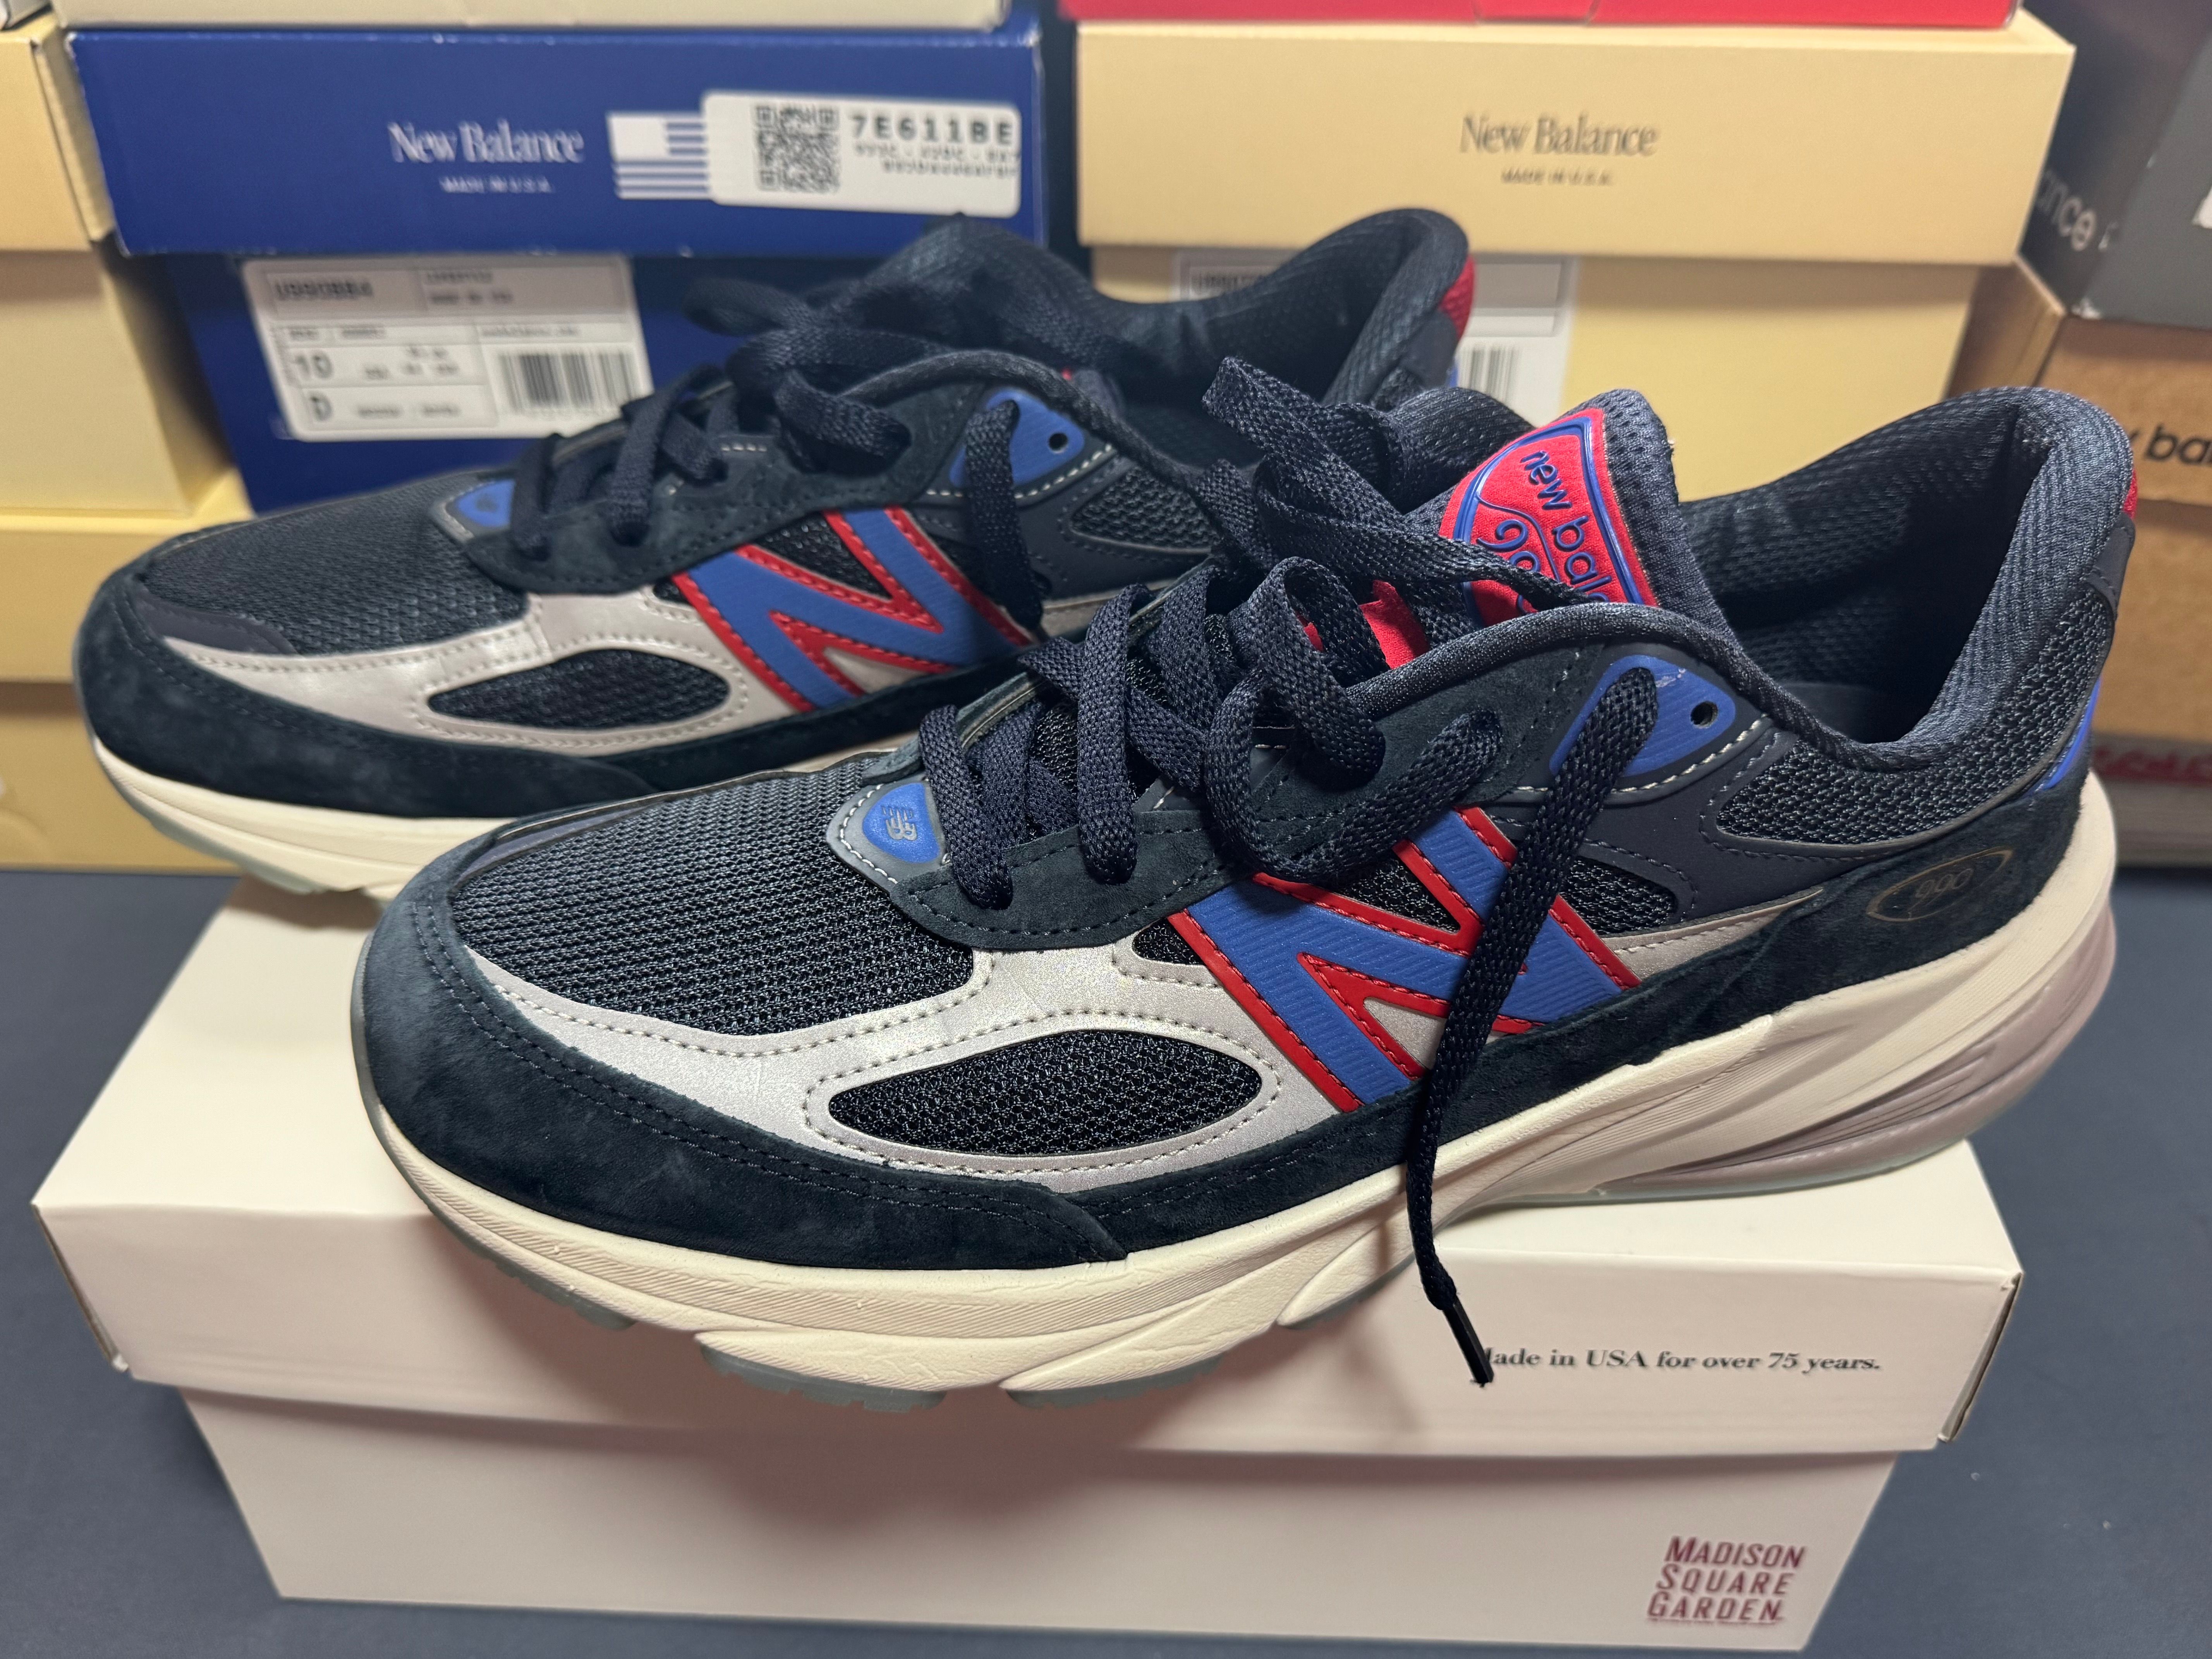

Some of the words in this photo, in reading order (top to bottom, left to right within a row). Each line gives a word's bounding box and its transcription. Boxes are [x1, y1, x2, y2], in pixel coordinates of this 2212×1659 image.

[387, 119, 457, 163] New
[459, 117, 584, 163] Balance
[852, 112, 1015, 145] 7E611BE
[1460, 112, 1530, 153] New
[1534, 112, 1659, 156] Balance
[2145, 423, 2212, 465] ba
[1520, 450, 1573, 510] new
[1484, 1347, 1540, 1365] ade
[1549, 1349, 1575, 1365] in
[1586, 1349, 1647, 1368] USA
[1656, 1351, 1695, 1368] for
[1702, 1356, 1760, 1369] over
[1767, 1352, 1800, 1369] 75
[1802, 1357, 1881, 1374] years.
[1664, 1536, 1805, 1568] MADISON
[1654, 1563, 1795, 1595] SQUARE
[1647, 1590, 1783, 1621] GARDEN
